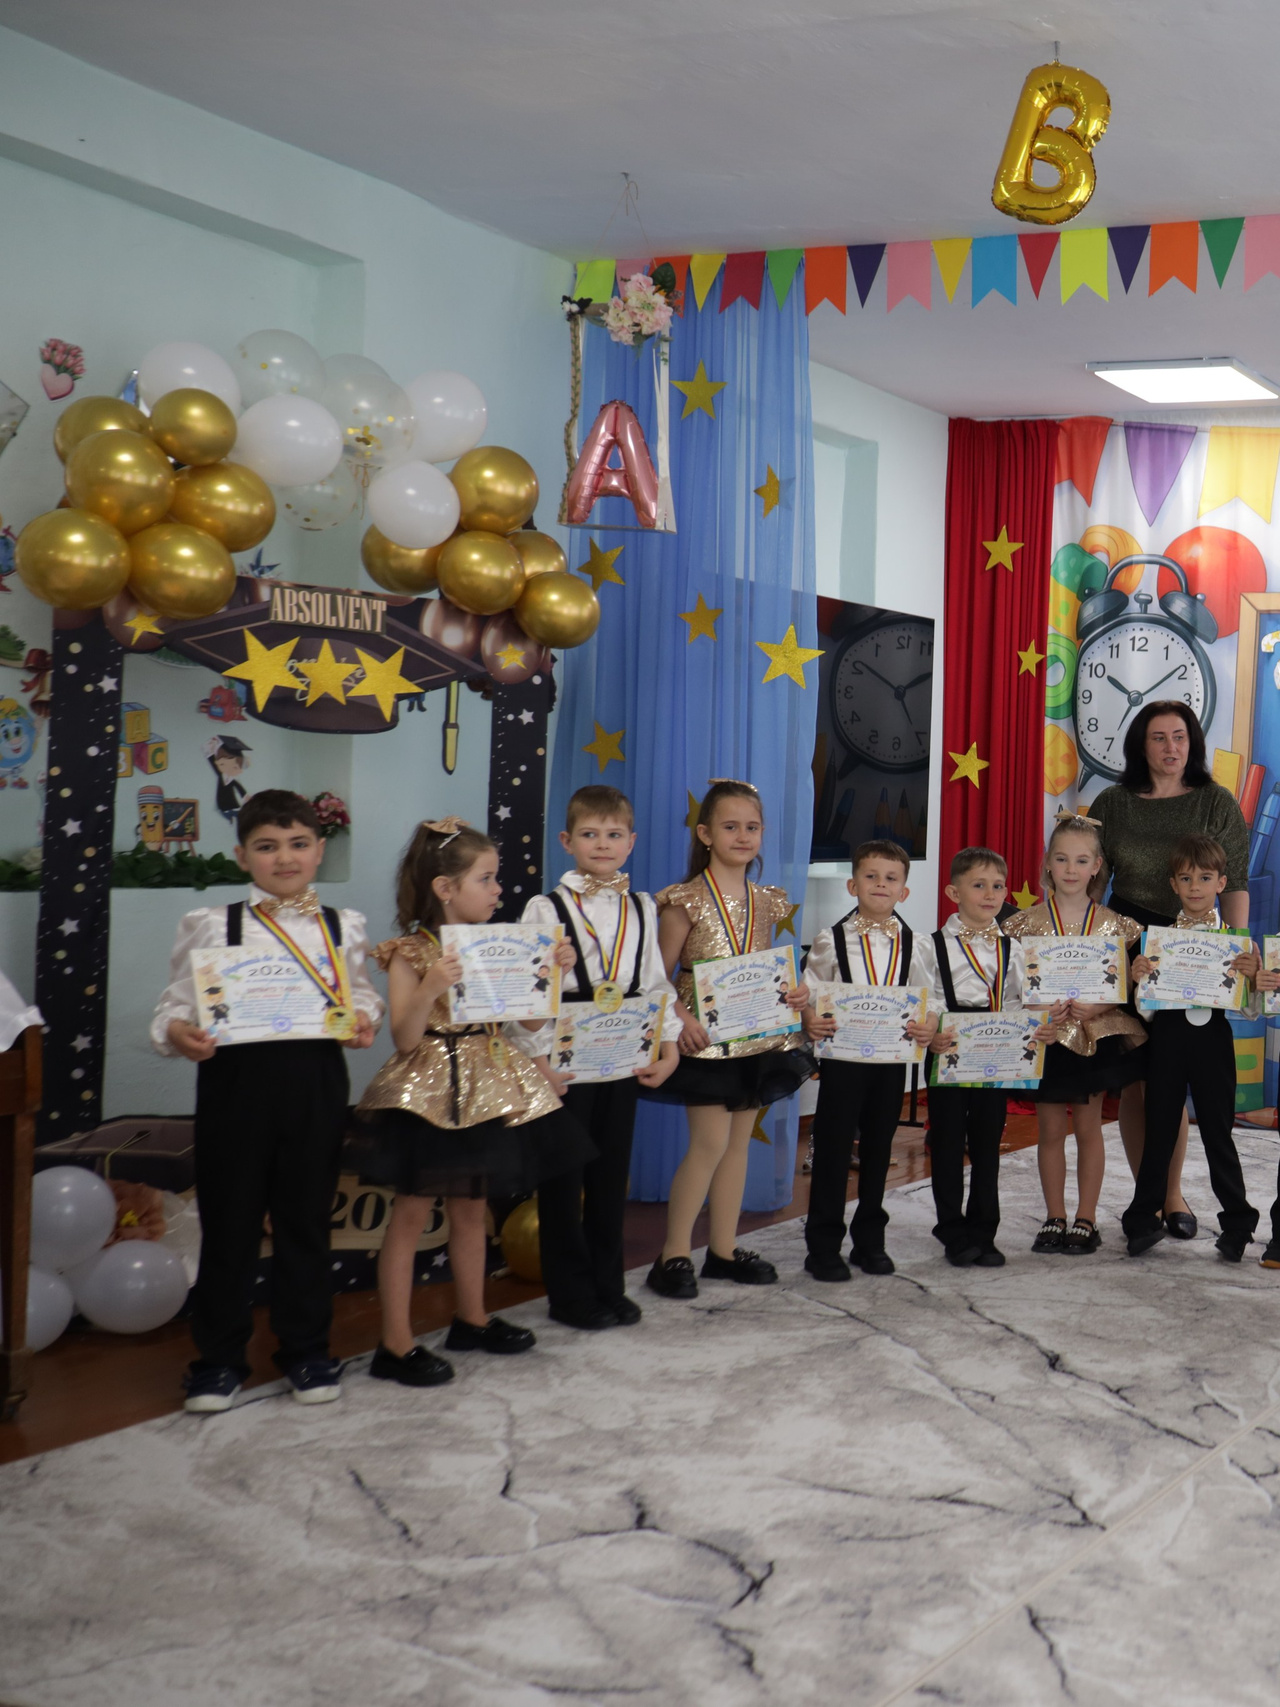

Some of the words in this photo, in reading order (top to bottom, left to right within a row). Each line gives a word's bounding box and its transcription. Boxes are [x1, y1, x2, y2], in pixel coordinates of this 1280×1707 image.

[991, 60, 1111, 225] B
[567, 399, 658, 528] A
[270, 587, 387, 633] ABSOLVENT
[1108, 643, 1120, 658] 11
[1130, 636, 1148, 652] 12
[1164, 645, 1170, 660] 1
[1088, 662, 1106, 678] 10
[1178, 664, 1188, 680] 2
[1082, 690, 1092, 704] 9
[1184, 693, 1192, 707] 3
[1087, 718, 1098, 732] 8
[1104, 737, 1114, 752] 7
[151, 747, 164, 769] C
[479, 945, 516, 958] 2026
[1056, 950, 1089, 959] 2026
[1178, 946, 1211, 957] 2026
[730, 972, 761, 984] 2026
[852, 1002, 888, 1012] 2026
[596, 1017, 631, 1029] 2026
[976, 1027, 1010, 1036] 2026
